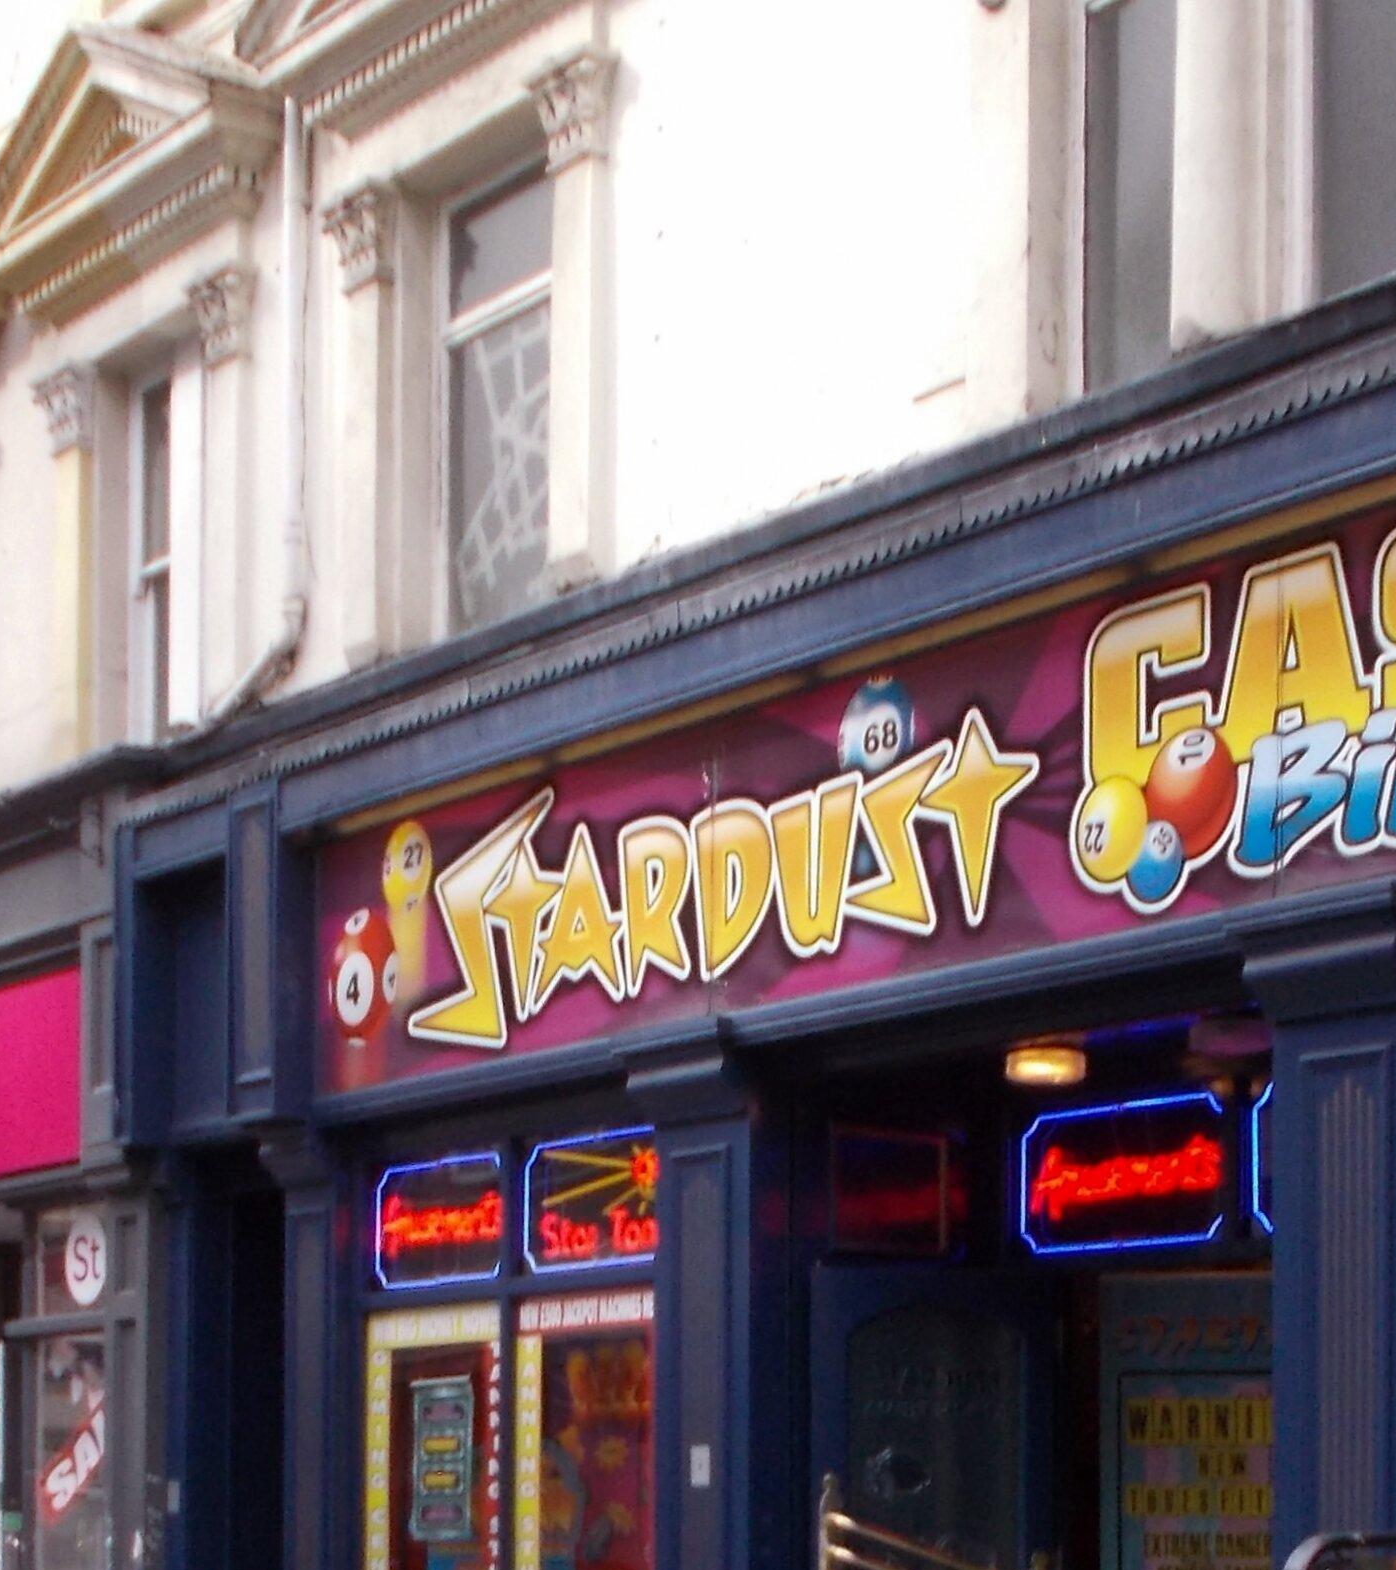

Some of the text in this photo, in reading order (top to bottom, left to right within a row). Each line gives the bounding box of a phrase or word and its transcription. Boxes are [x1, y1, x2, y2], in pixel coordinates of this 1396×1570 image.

[864, 719, 899, 755] 68
[402, 841, 424, 869] 27
[410, 710, 1037, 1046] STARDUST
[345, 971, 360, 1006] 4
[73, 1234, 101, 1282] St
[1127, 1403, 1272, 1441] WARNI
